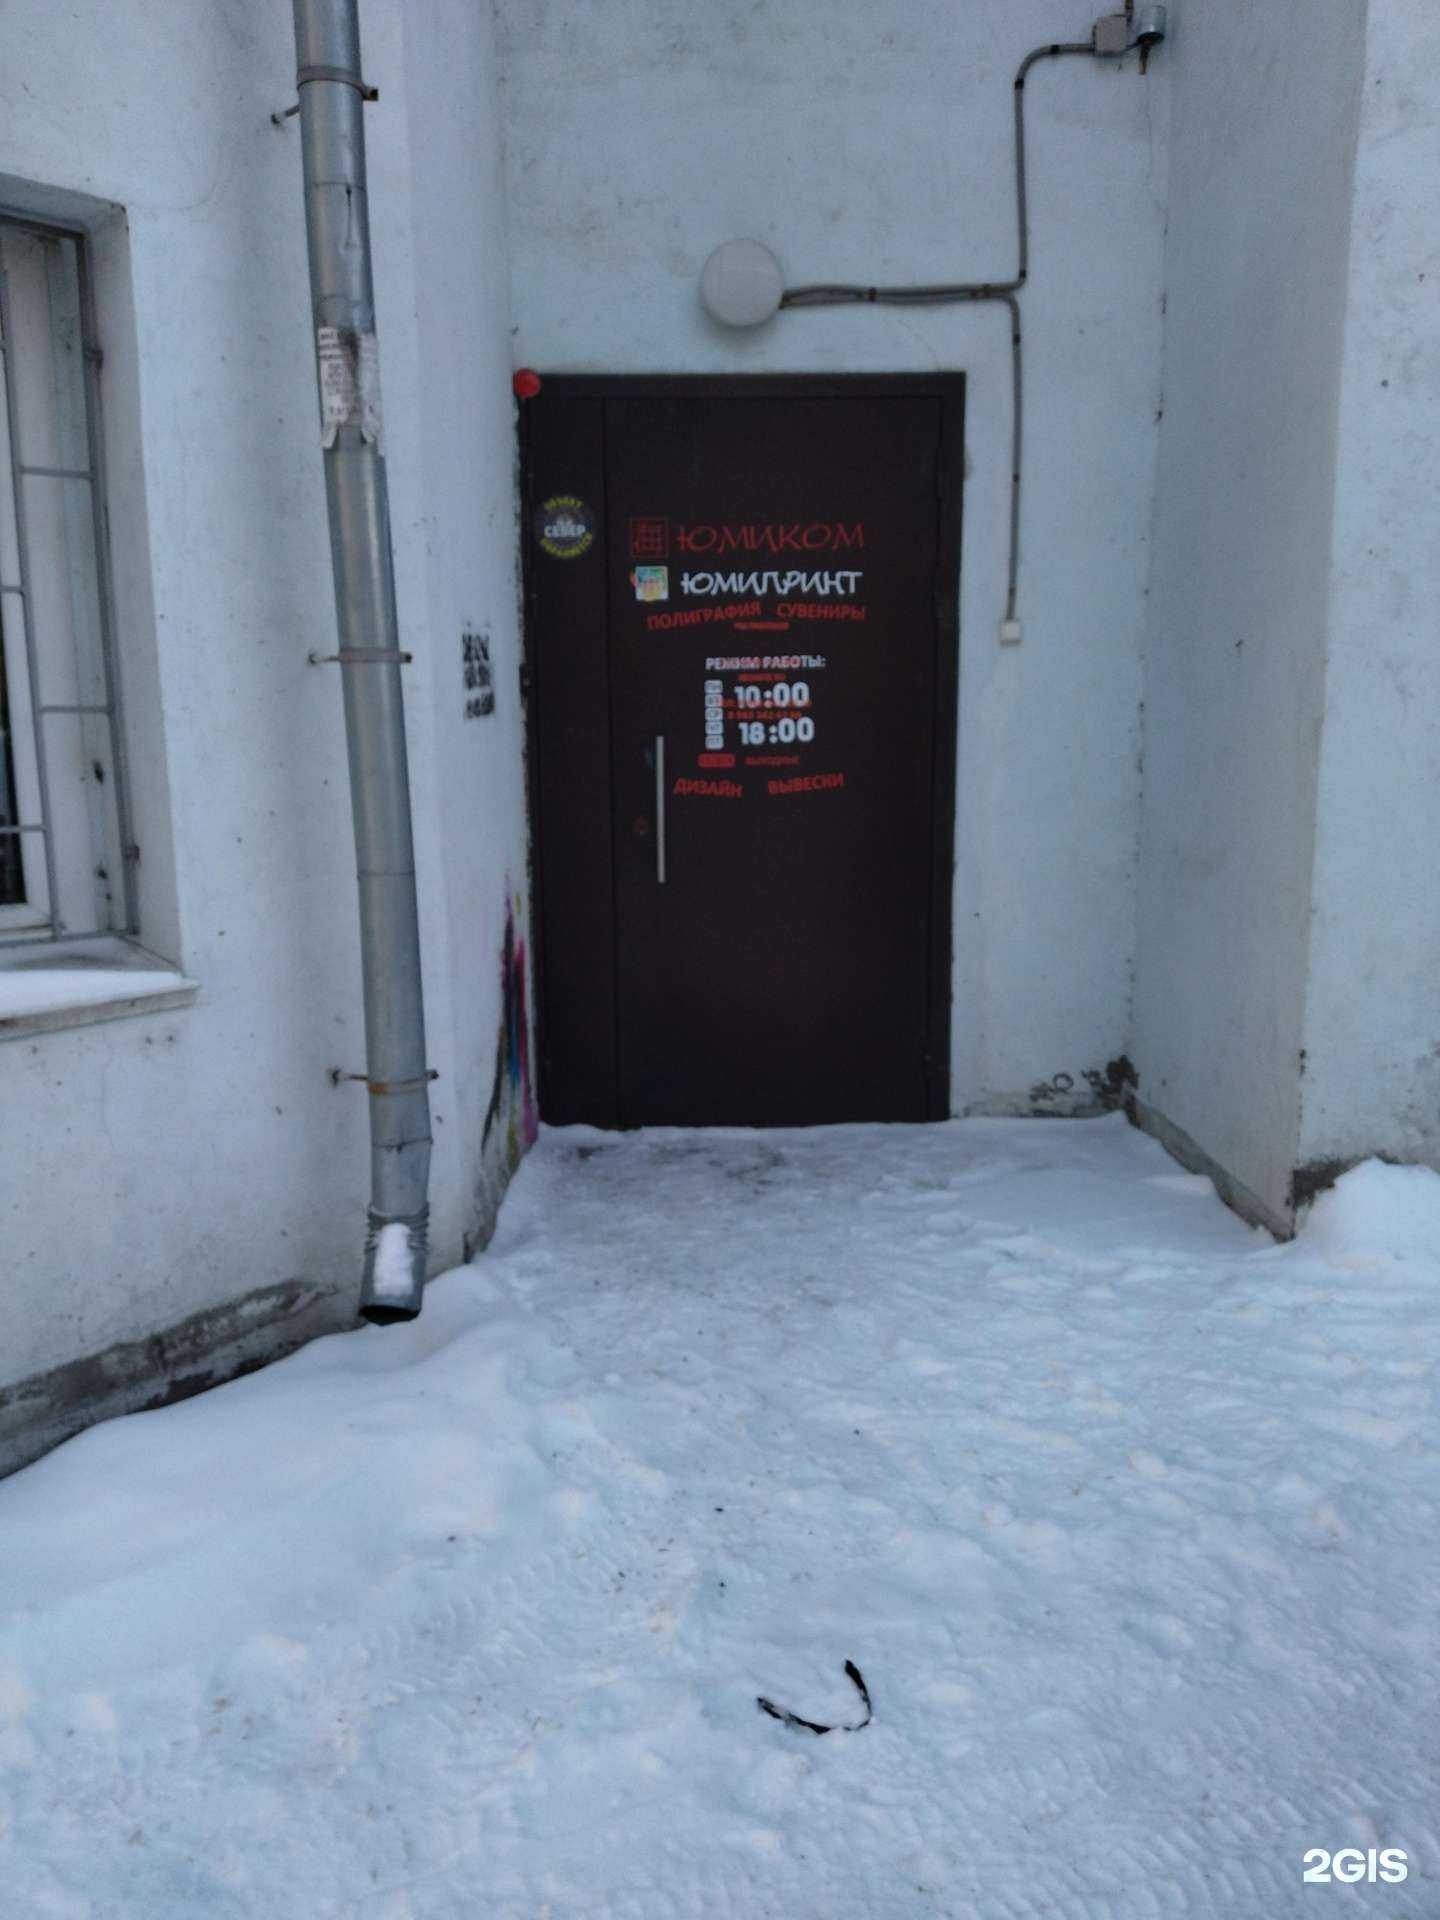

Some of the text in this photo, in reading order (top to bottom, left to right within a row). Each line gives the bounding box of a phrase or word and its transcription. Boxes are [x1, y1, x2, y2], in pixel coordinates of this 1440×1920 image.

[676, 522, 866, 554] ЮМИКОМ
[680, 570, 863, 597] ЮМИПРИНТ
[646, 601, 762, 630] ПОЛИГРАФИЯ
[776, 601, 866, 621] СУВЕНИРЫ
[705, 655, 827, 671] РЕЖИМ РАБОТЫ:
[733, 681, 810, 710] 10:00
[738, 717, 815, 747] 18:00
[672, 773, 845, 798] ДИЗАЙН ВЫВЕСКИ
